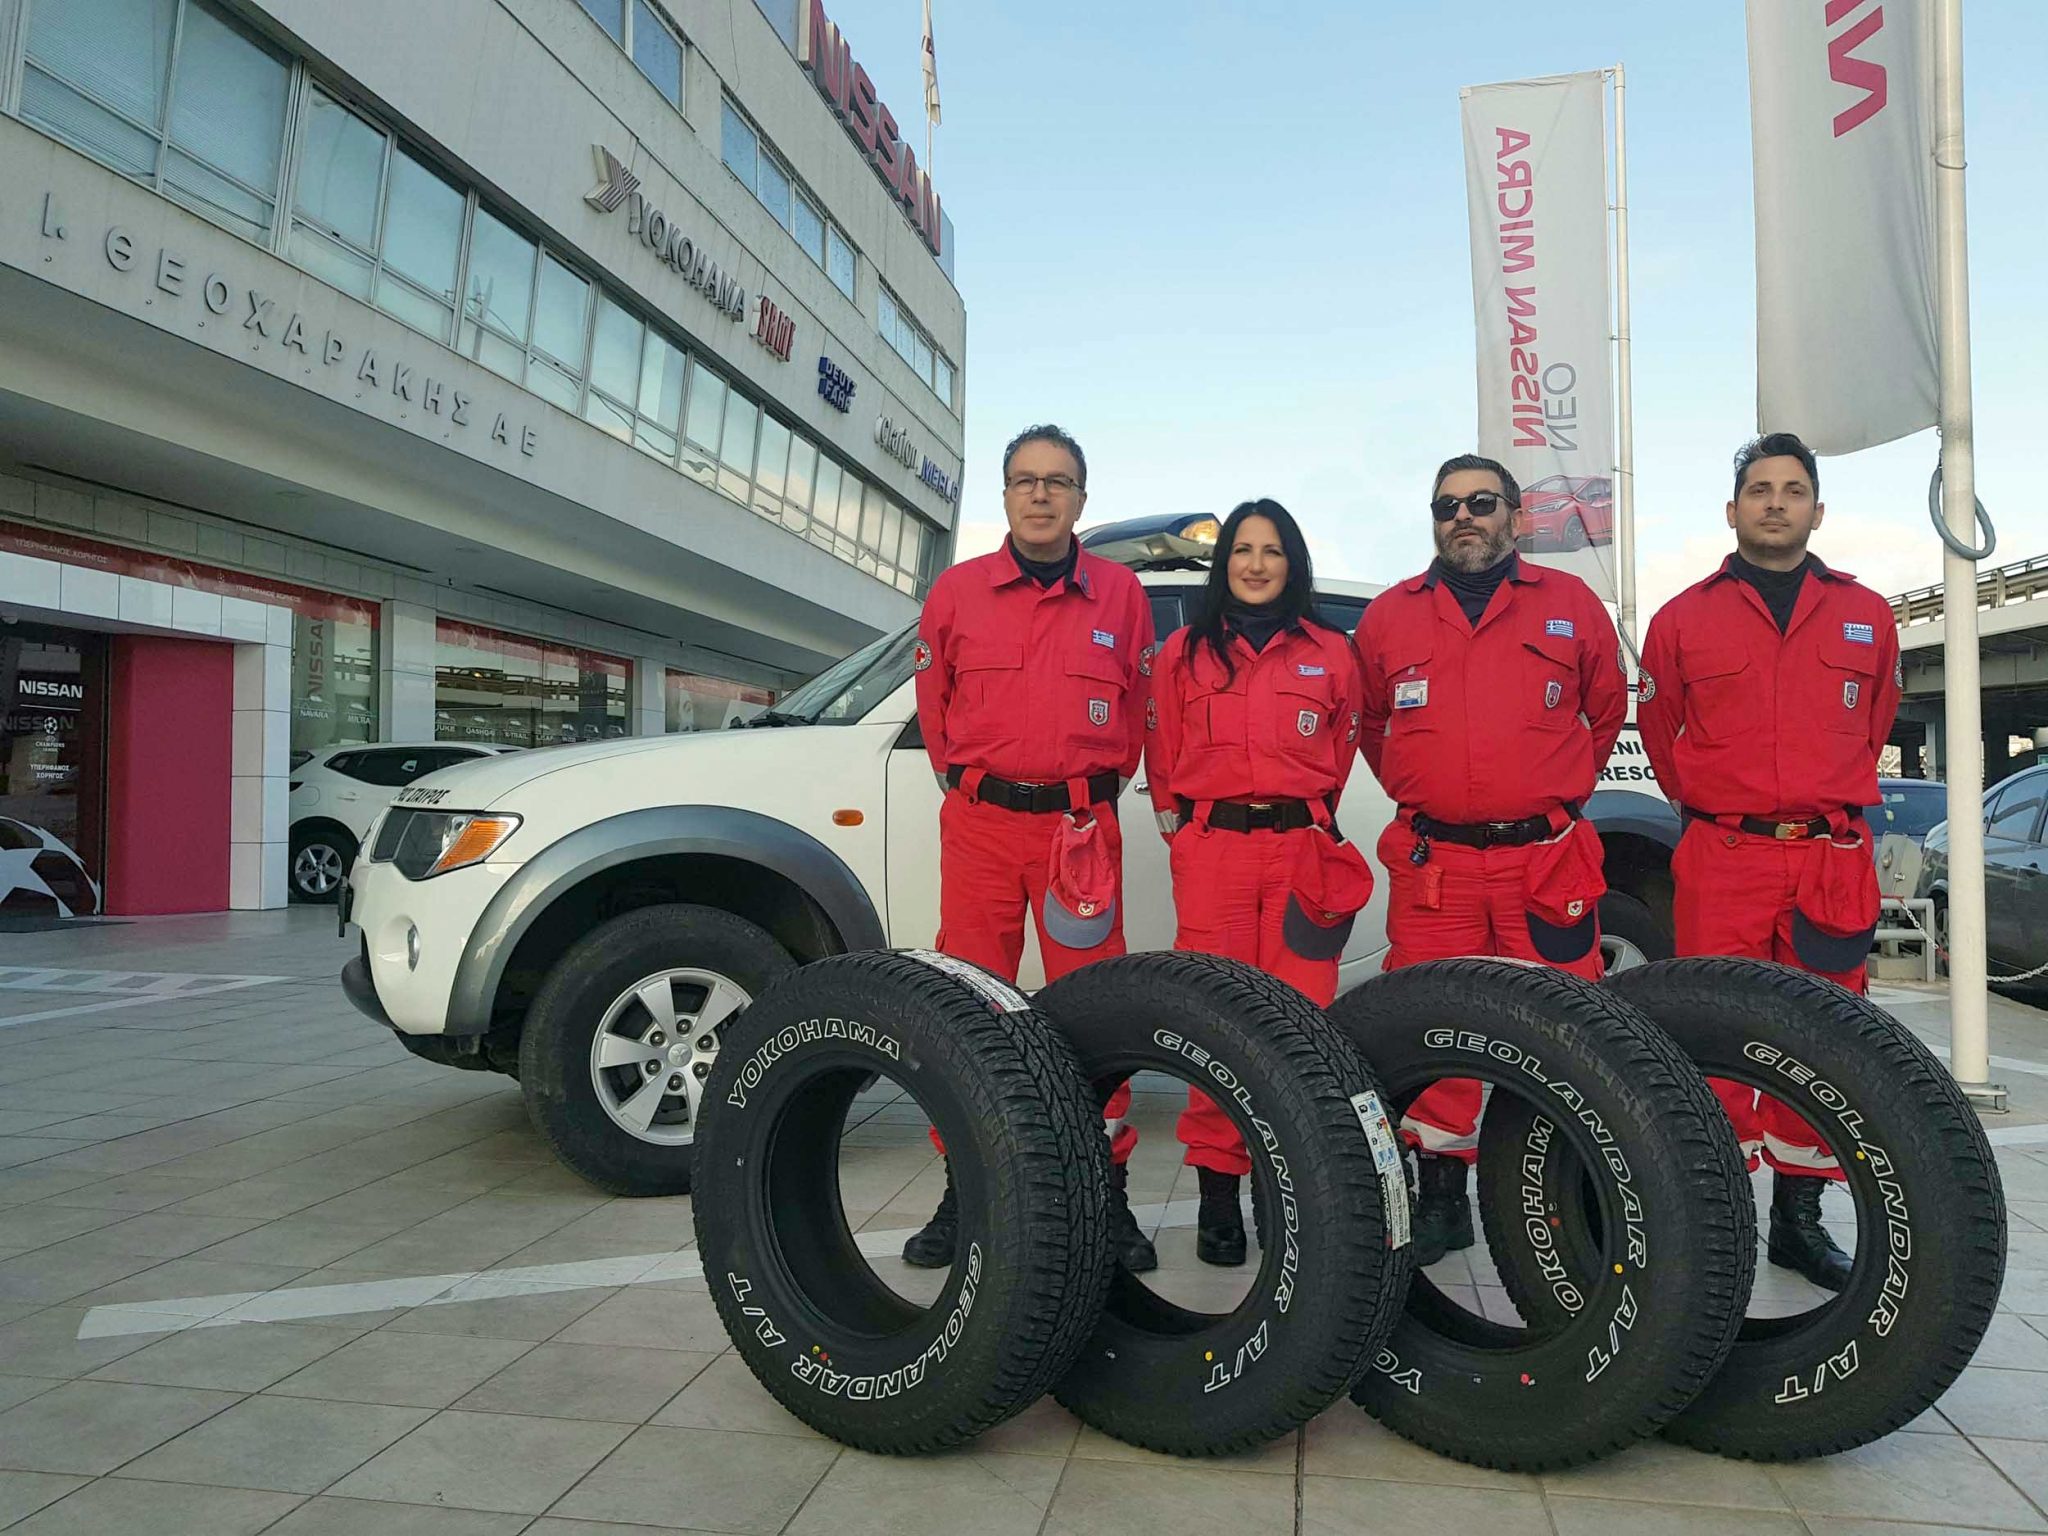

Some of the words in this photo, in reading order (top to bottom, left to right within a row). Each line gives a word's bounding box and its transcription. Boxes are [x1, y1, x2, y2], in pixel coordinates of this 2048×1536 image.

[800, 0, 941, 257] NISSAN
[628, 192, 745, 322] YOKOHAMA
[105, 226, 470, 426] ΘΕΟΧΑΡΑΚΗΣ
[491, 412, 540, 457] ΑΕ
[818, 356, 857, 397] DEUTZ
[818, 378, 852, 413] FAHR
[875, 414, 919, 470] Clarion
[19, 679, 83, 699] NISSAN
[727, 1018, 904, 1109] YOKOHAMA
[1153, 1028, 1299, 1314] GEOLANDAR
[1424, 1028, 1647, 1269] GEOLANDAR
[1743, 1041, 1911, 1338] GEOLANDAR
[727, 1272, 787, 1348] A/T
[790, 1242, 982, 1400] GEOLANDAR
[1204, 1320, 1268, 1393] A/T
[1585, 1284, 1638, 1383] A/T
[1774, 1339, 1859, 1404] A/T
